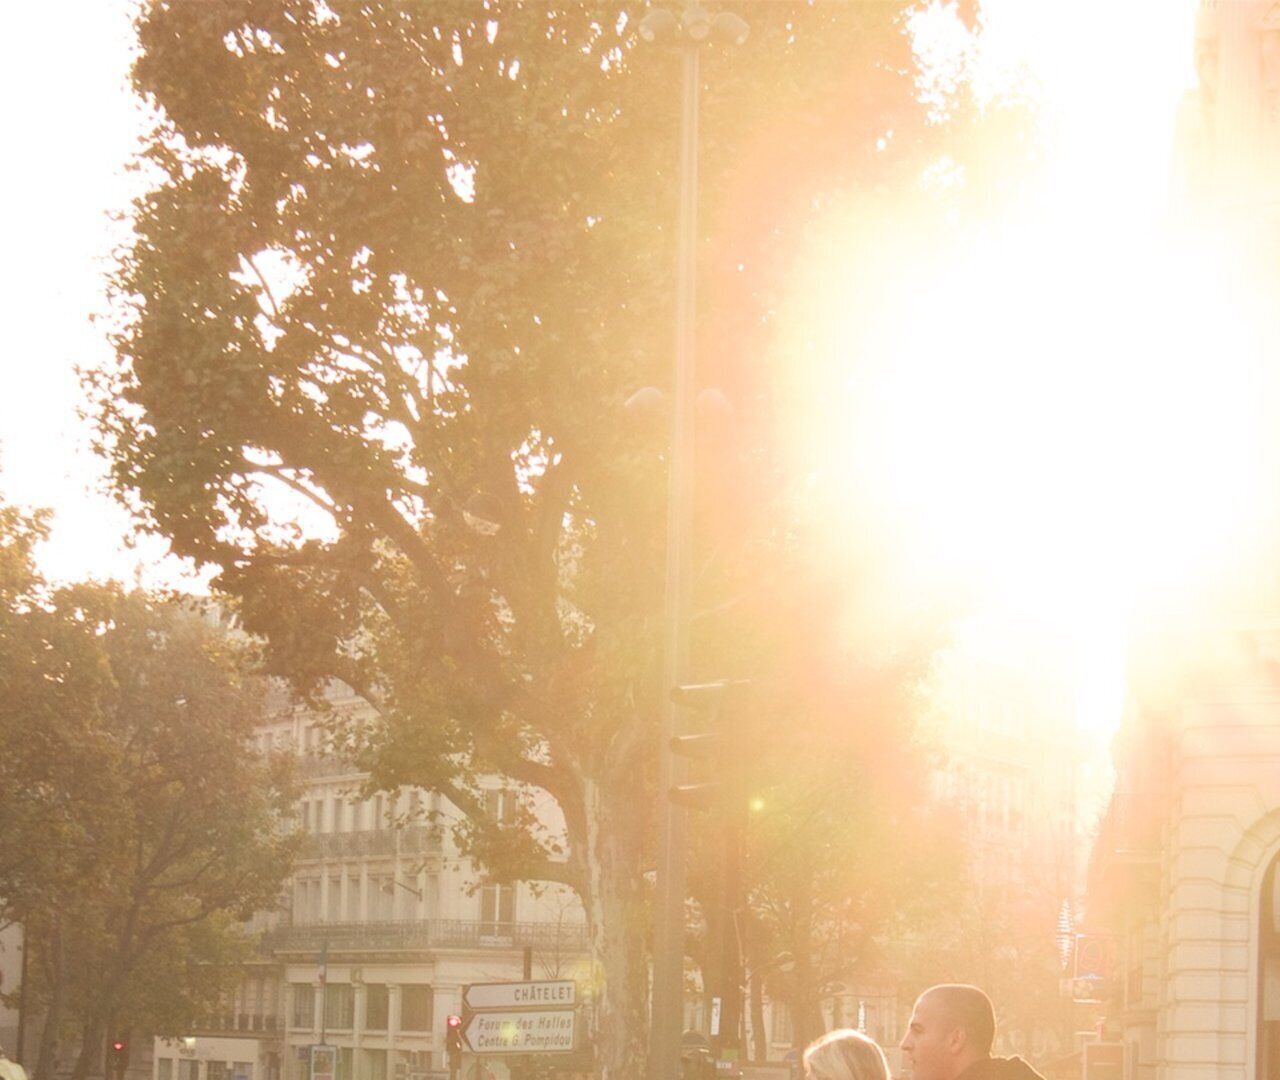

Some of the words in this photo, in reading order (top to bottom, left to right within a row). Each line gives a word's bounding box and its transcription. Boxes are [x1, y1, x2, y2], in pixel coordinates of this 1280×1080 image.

[514, 985, 572, 1001] CHÂTELET
[516, 1018, 534, 1030] des
[538, 1016, 572, 1030] Halles
[478, 1034, 509, 1047] Centre
[524, 1033, 571, 1048] Pompidou
